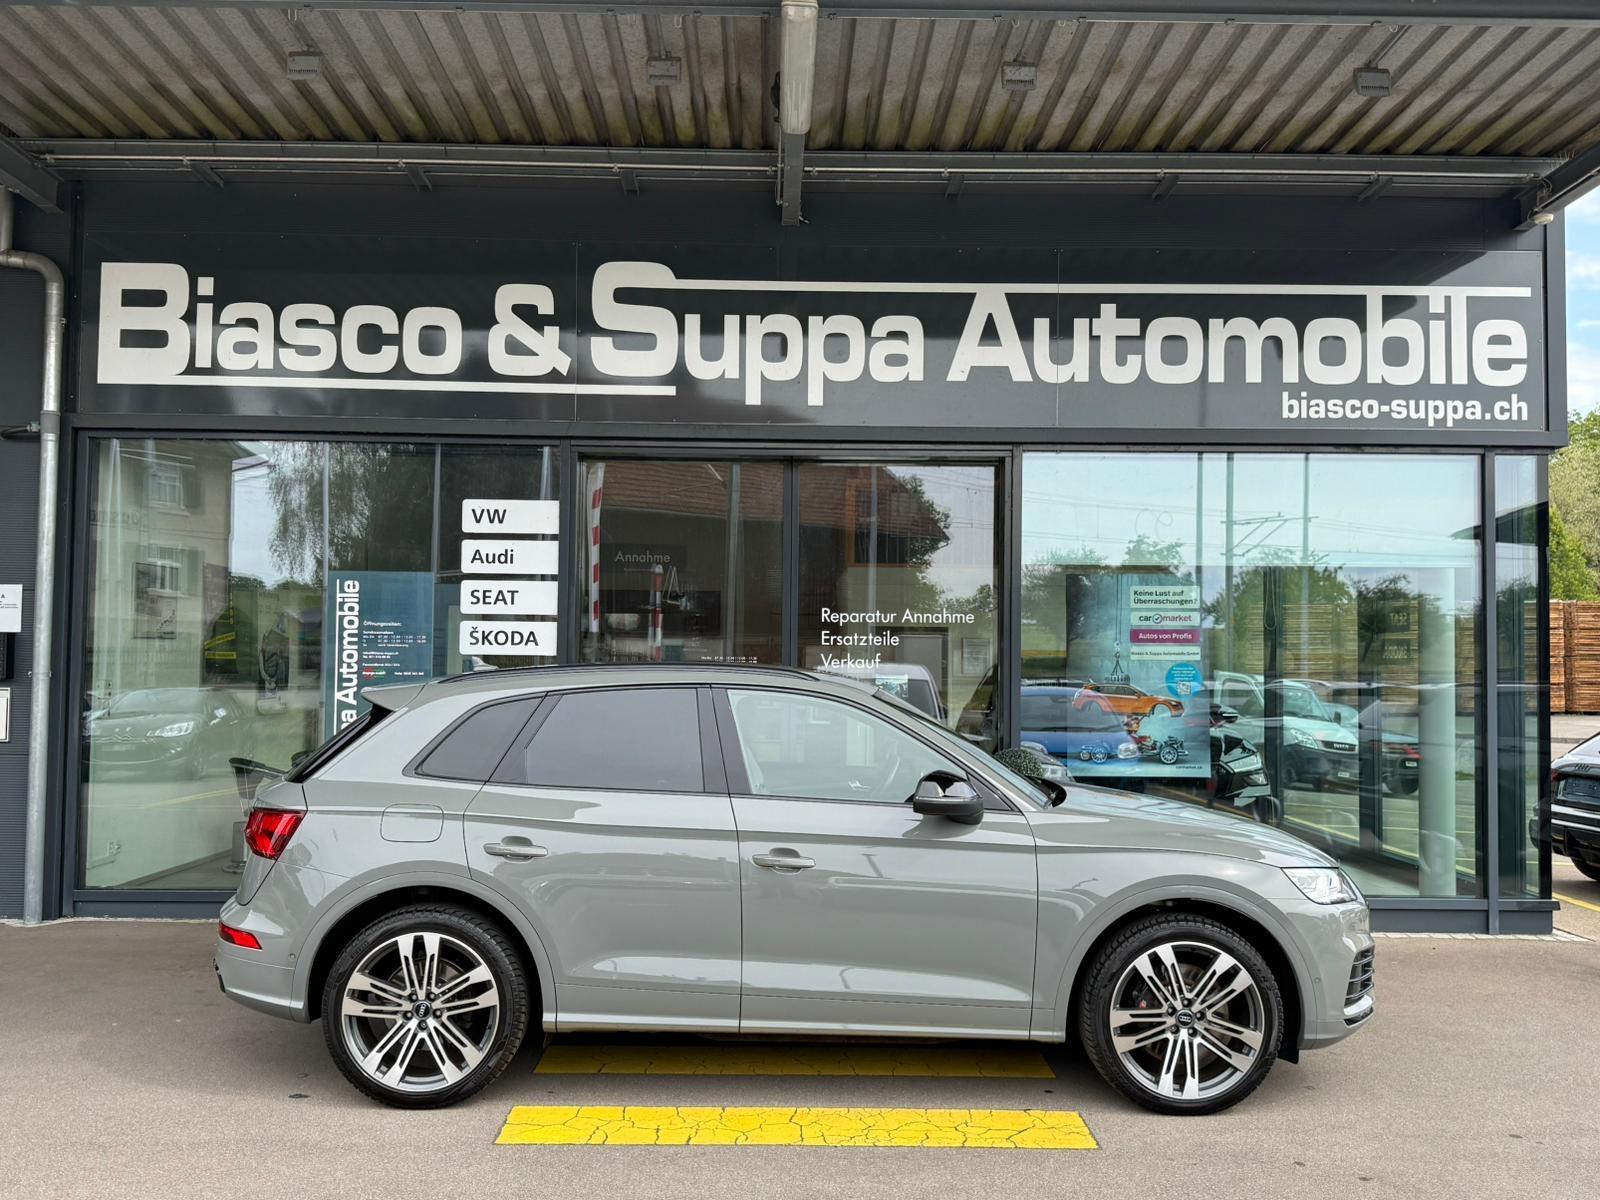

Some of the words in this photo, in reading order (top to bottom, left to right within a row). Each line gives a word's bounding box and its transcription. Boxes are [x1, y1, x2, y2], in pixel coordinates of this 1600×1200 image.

[97, 262, 462, 384] Biasco
[487, 284, 572, 377] &
[590, 261, 925, 406] Suppa
[946, 283, 1528, 387] Automobile
[1282, 391, 1528, 428] biasco-suppa.ch
[471, 508, 507, 525] VW
[470, 549, 514, 565] Audi
[615, 551, 671, 563] Annahme
[470, 589, 519, 605] SEAT
[1133, 589, 1154, 597] Keine
[1133, 597, 1198, 606] Überraschungen?
[821, 608, 896, 626] Reparatur
[902, 608, 975, 625] Annahme
[337, 579, 360, 705] Automobile
[469, 626, 539, 646] ŠKODA
[821, 630, 900, 647] Ersatzteile
[1138, 632, 1158, 640] Autos
[1172, 632, 1193, 640] Profis
[820, 653, 881, 669] Verkauf
